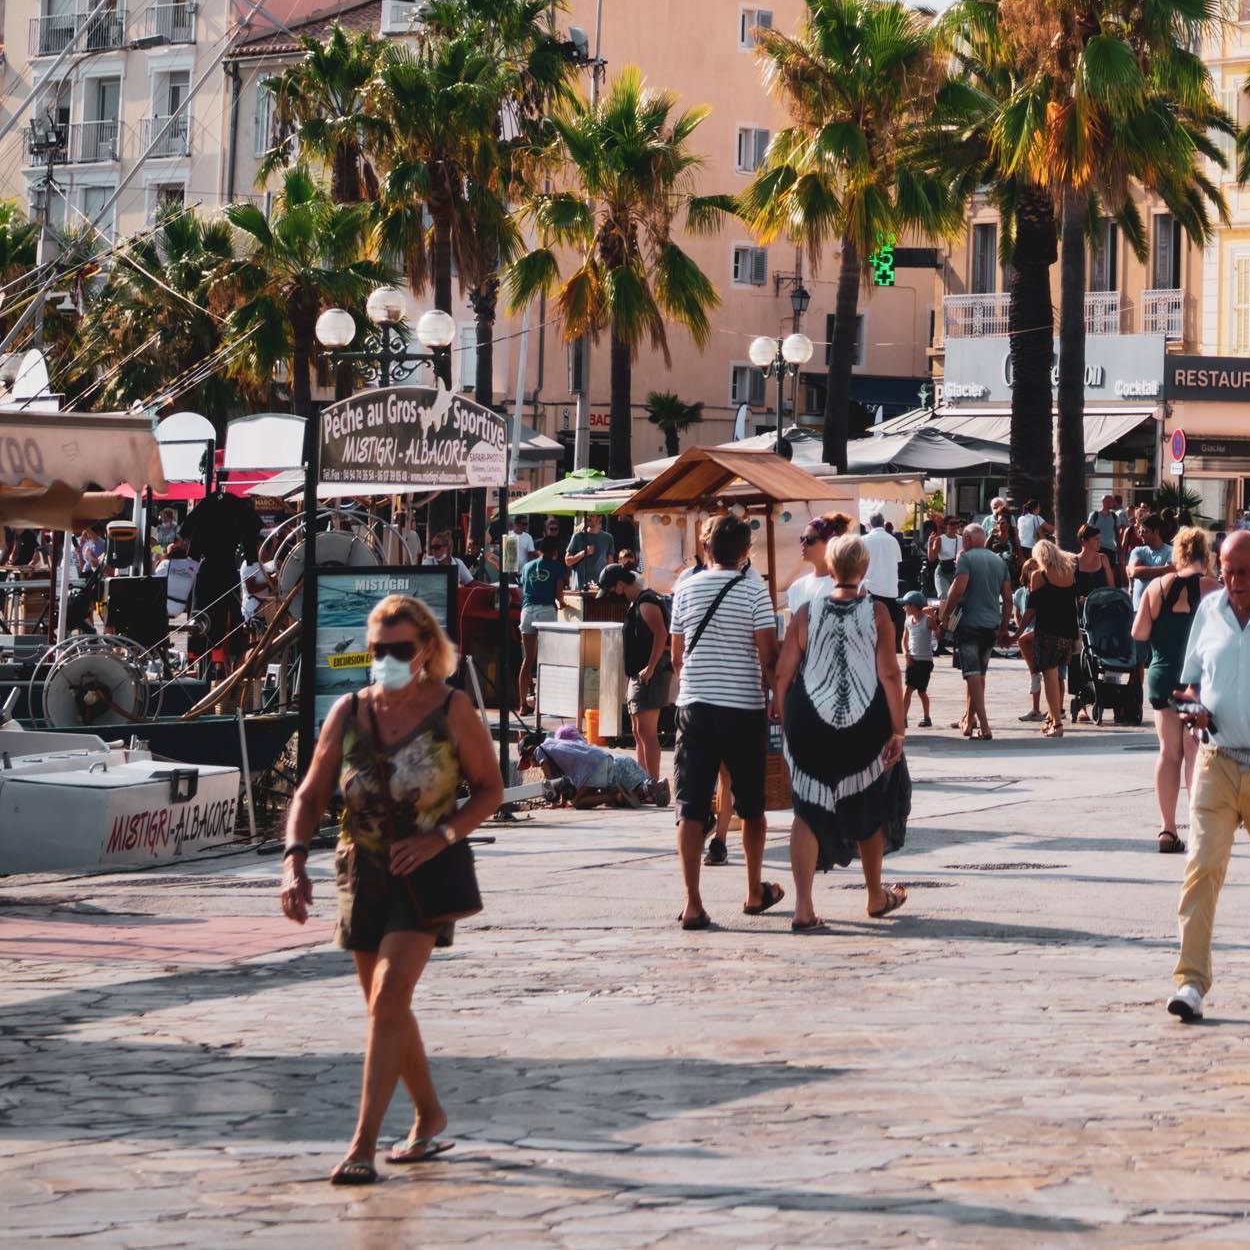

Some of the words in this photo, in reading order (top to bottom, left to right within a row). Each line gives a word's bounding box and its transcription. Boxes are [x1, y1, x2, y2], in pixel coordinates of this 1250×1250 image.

[945, 382, 985, 399] Glacier
[1114, 379, 1160, 397] Cocktail
[324, 402, 364, 444] Pêche
[367, 401, 384, 426] au
[387, 393, 417, 424] Gros
[453, 400, 505, 450] Sportive
[342, 435, 399, 467] MISTIGRI
[404, 437, 468, 469] ALBACORE
[355, 578, 409, 591] MISTIGRI
[333, 654, 365, 668] EXCURSION
